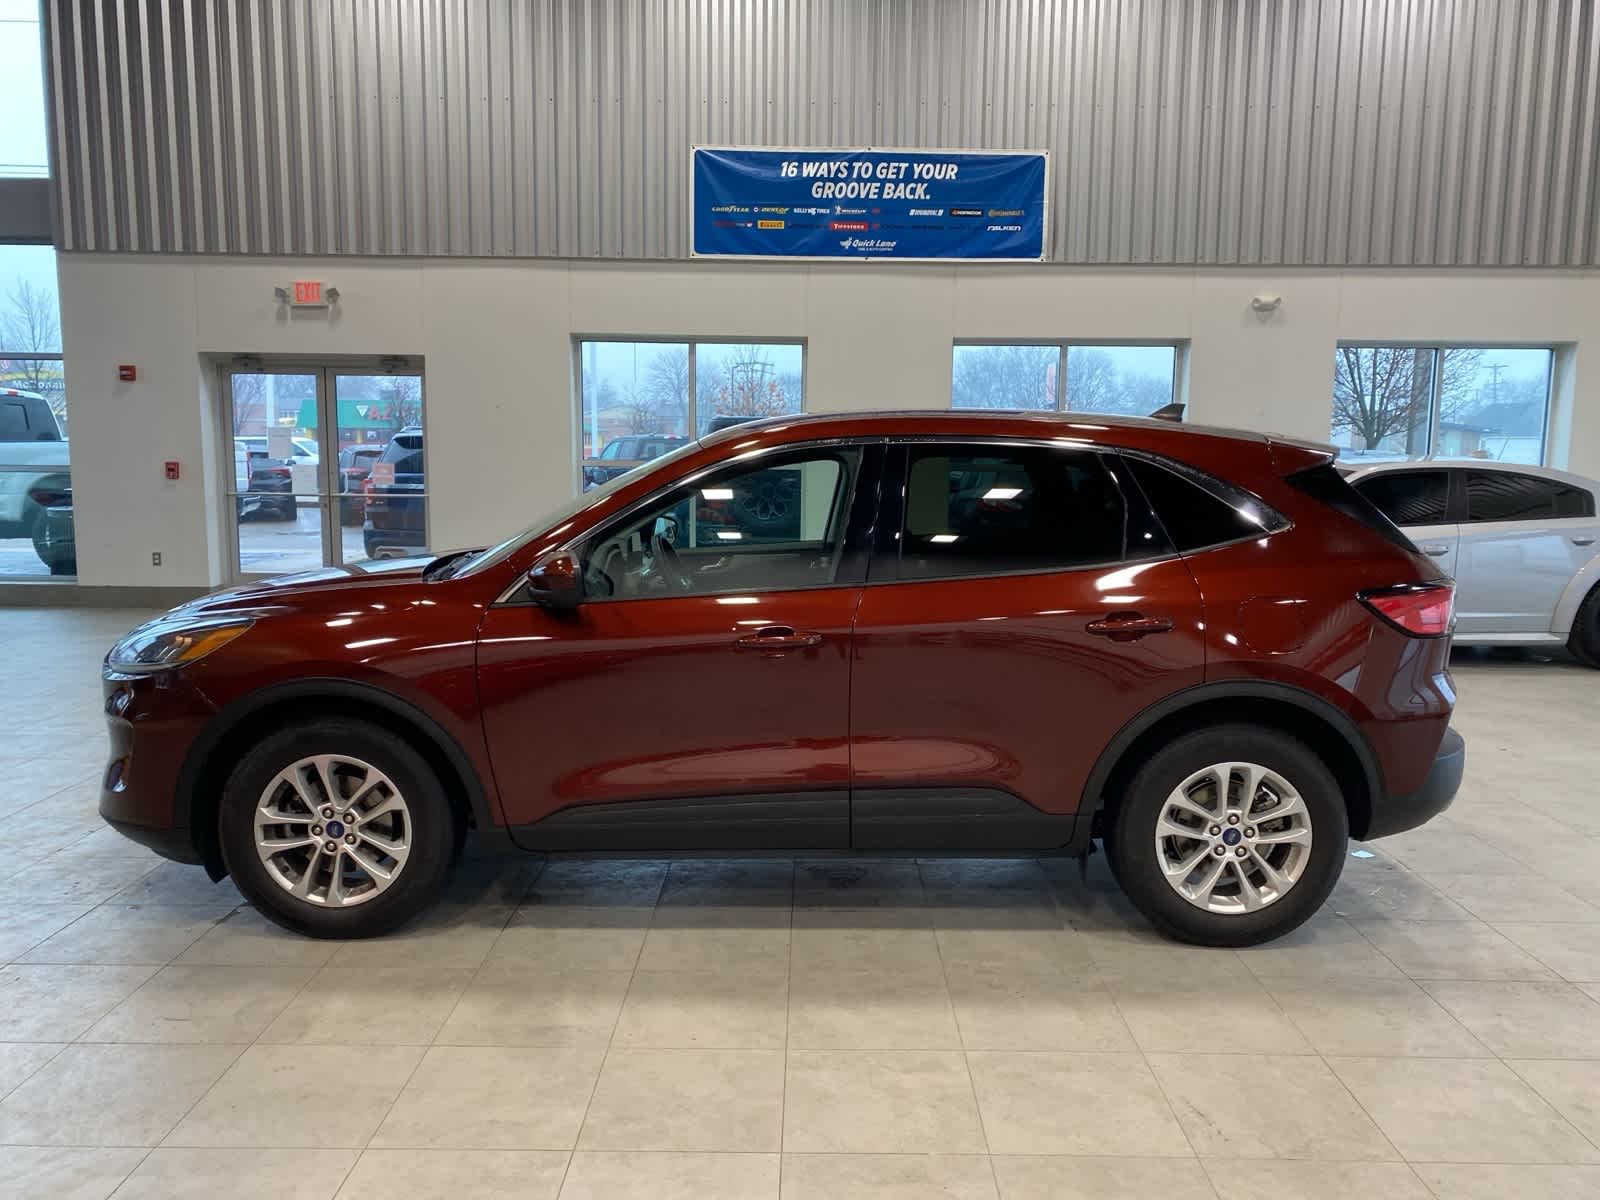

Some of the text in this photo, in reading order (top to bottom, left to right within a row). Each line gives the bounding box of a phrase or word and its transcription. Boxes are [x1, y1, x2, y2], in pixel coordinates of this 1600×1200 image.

[780, 161, 959, 180] 16 WAYS TO GET YOUR
[811, 181, 931, 200] GROOVE BACK.
[711, 205, 750, 213] GOODYEAR
[851, 239, 897, 248] Quick Lane
[293, 280, 321, 304] EXIT
